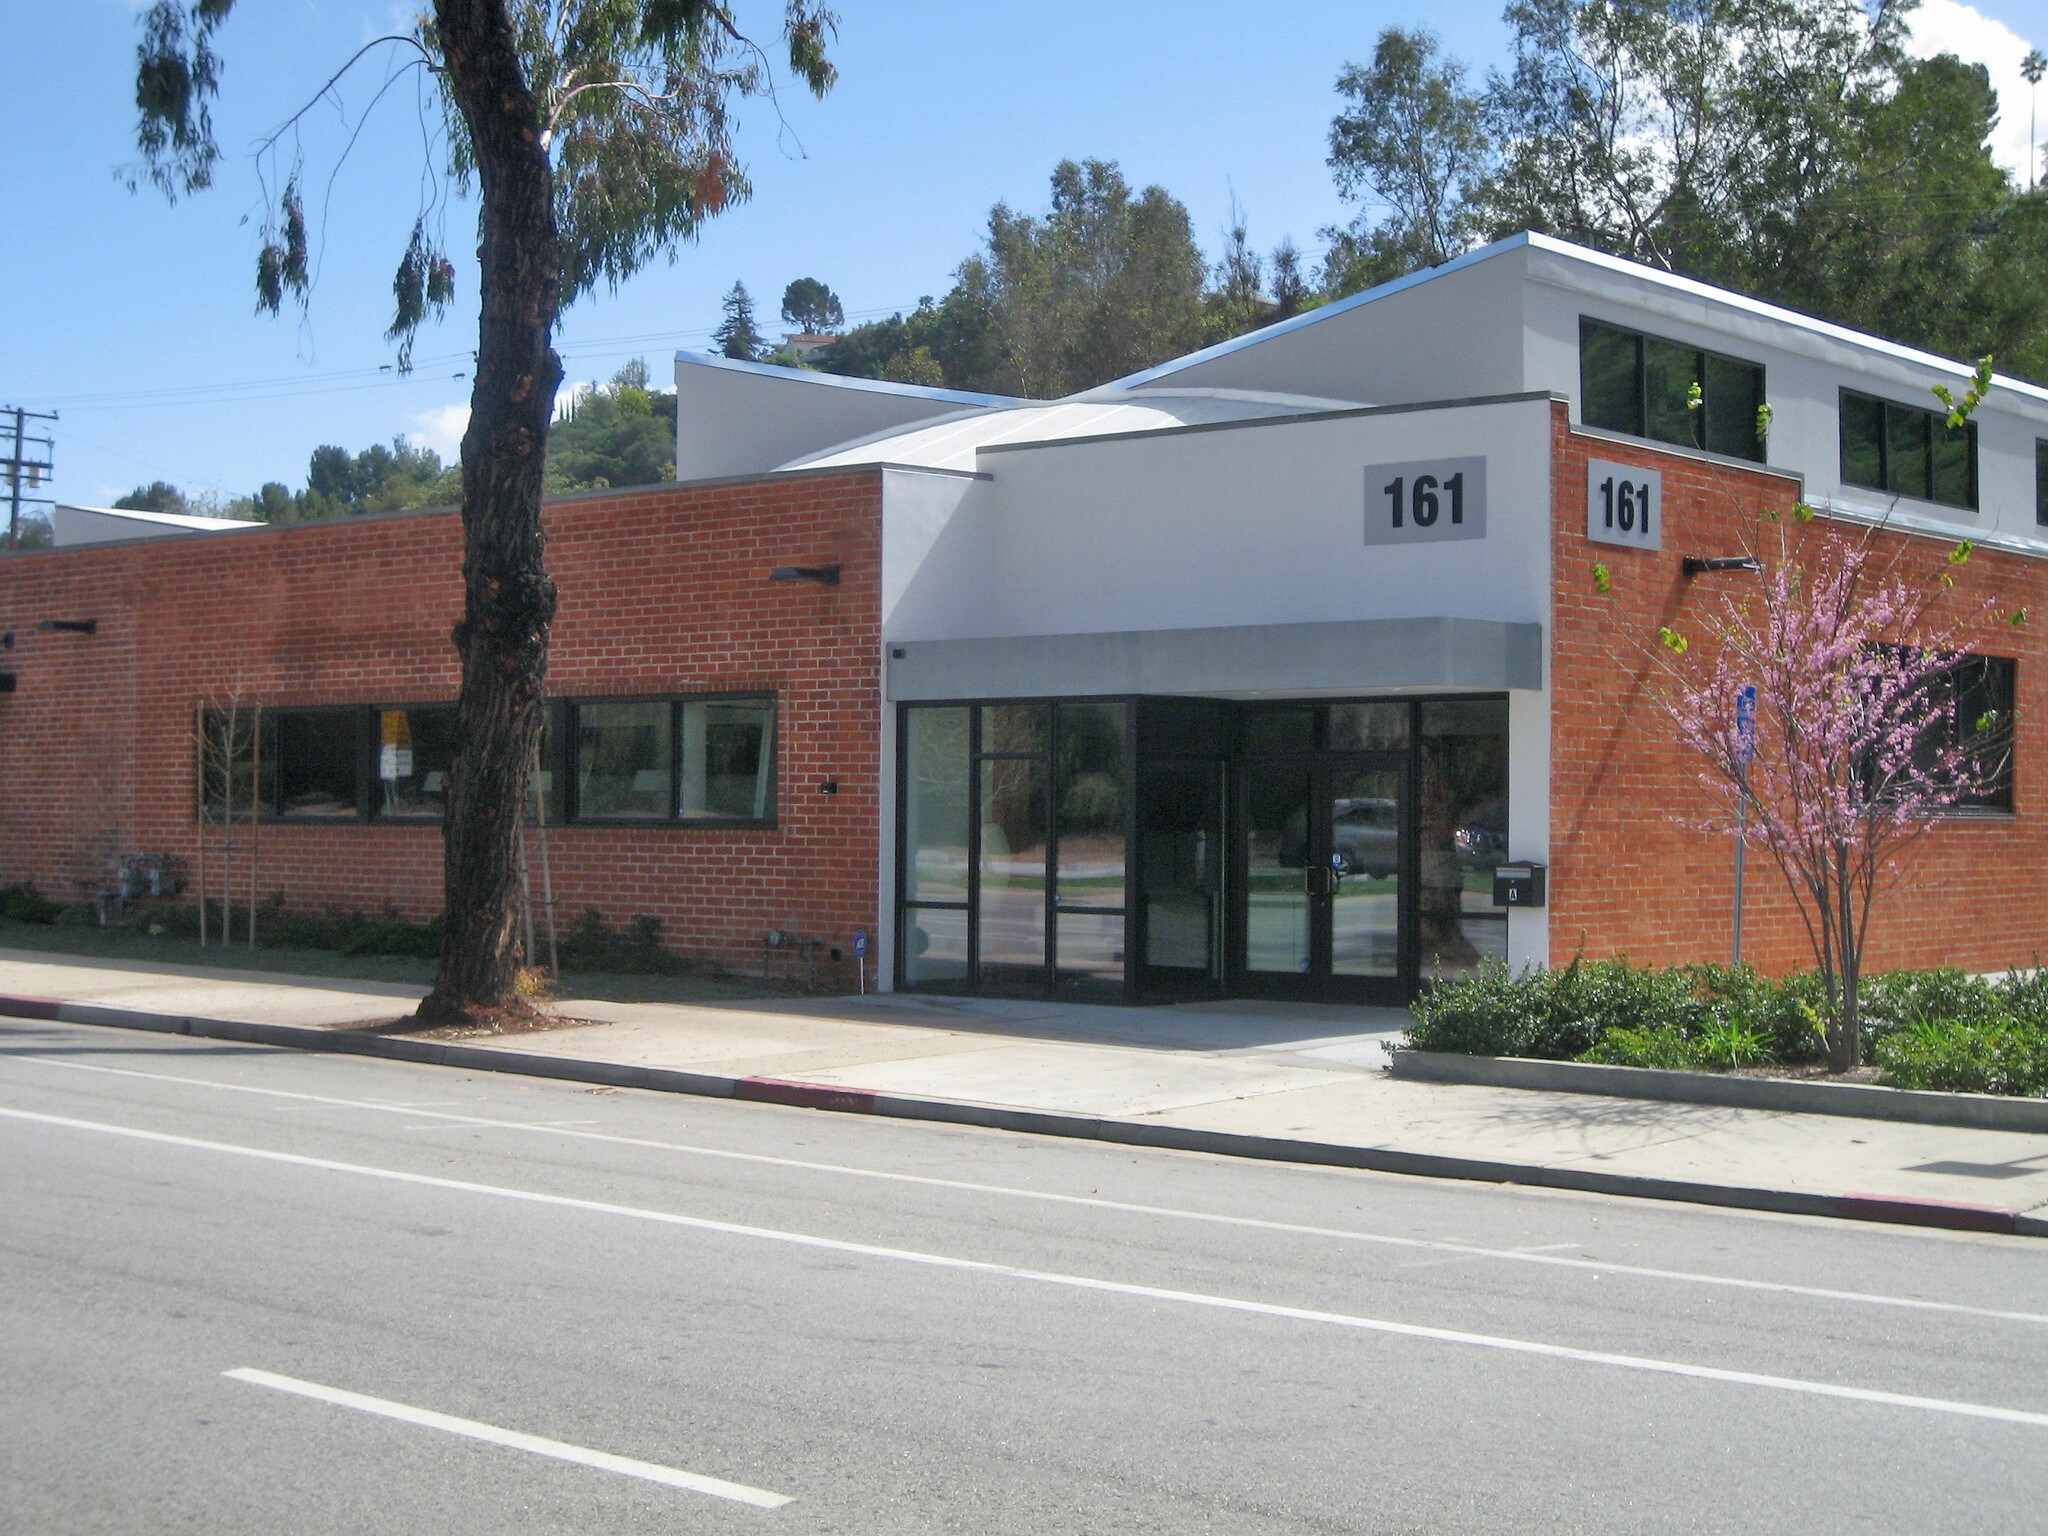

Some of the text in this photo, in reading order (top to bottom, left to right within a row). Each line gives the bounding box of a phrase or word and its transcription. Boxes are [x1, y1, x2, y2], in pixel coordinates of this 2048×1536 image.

[1384, 473, 1464, 528] 161
[1601, 477, 1649, 533] 161
[1509, 888, 1518, 901] A
